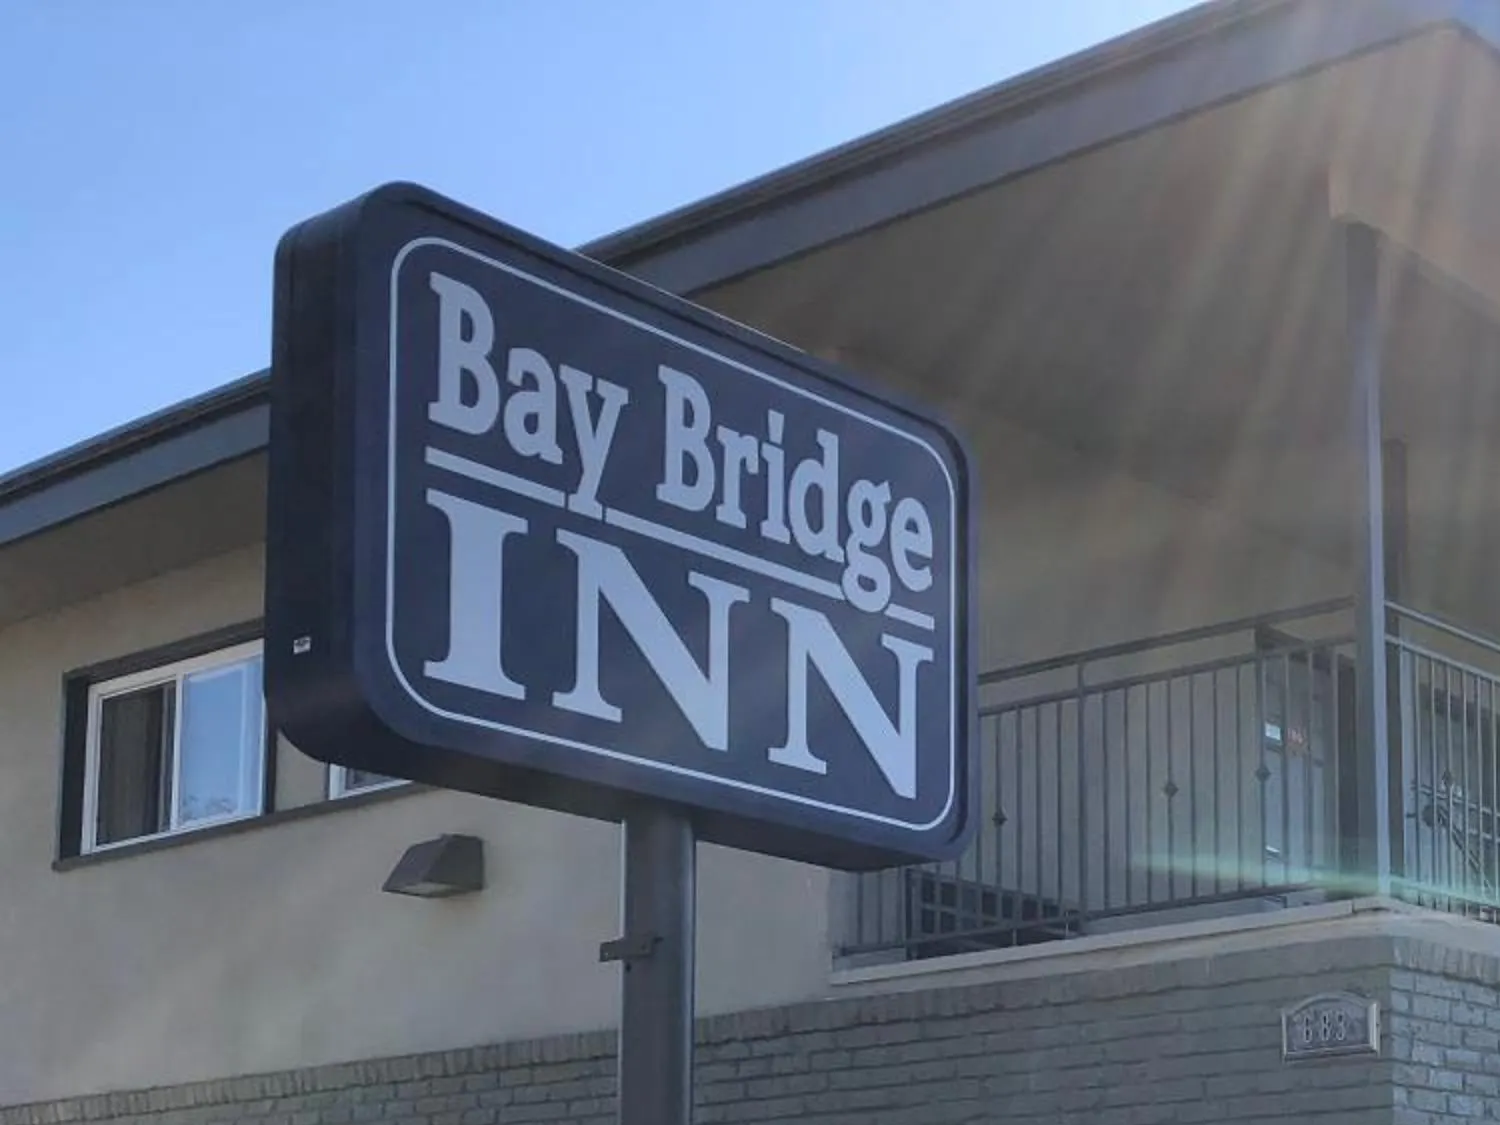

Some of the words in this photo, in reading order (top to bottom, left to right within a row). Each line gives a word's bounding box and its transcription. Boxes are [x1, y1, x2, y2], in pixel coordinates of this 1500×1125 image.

[426, 271, 629, 510] Bay
[655, 364, 934, 614] Bridge
[422, 488, 935, 799] INN
